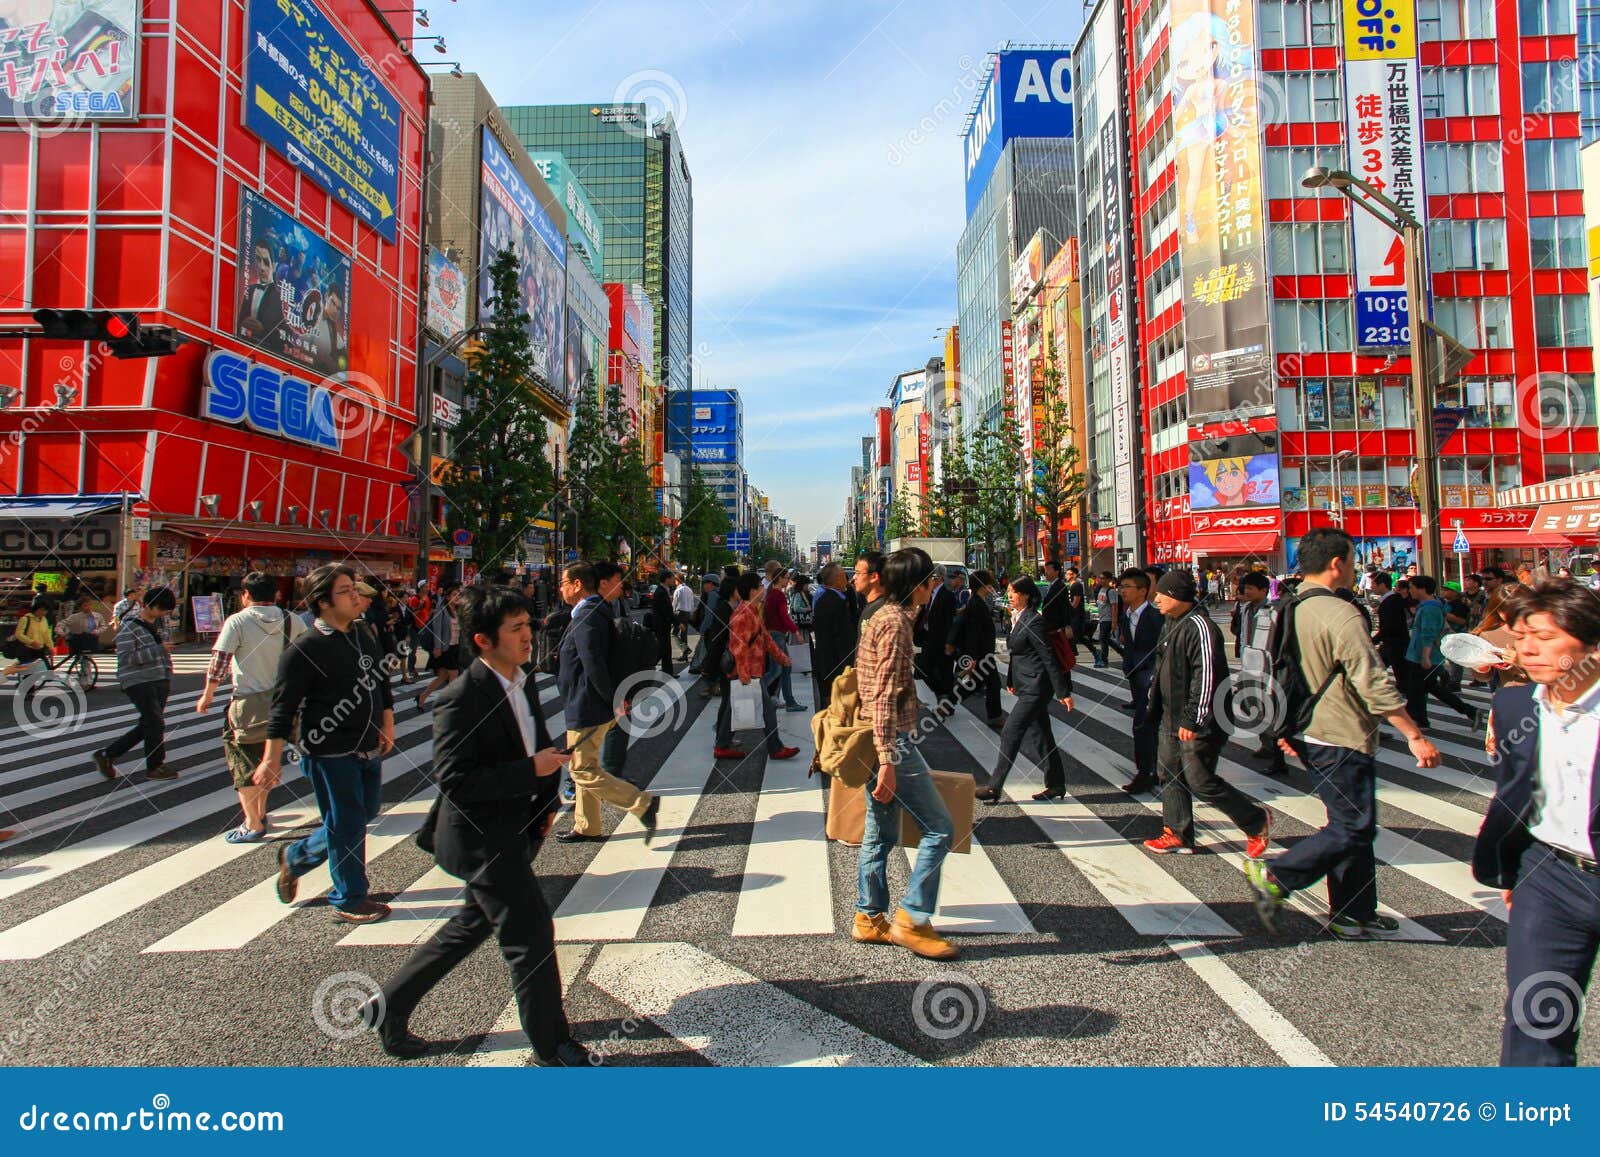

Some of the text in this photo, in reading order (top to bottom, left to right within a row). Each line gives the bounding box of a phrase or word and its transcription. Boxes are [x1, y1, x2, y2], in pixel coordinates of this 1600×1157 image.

[1357, 0, 1384, 52] OFF
[56, 91, 123, 112] SEGA
[967, 79, 996, 182] AOKI
[1365, 296, 1409, 313] 10:0
[1365, 326, 1411, 343] 23:0
[205, 349, 340, 451] SEGA
[691, 425, 727, 434] フマップ
[1213, 515, 1276, 527] ADORES
[1481, 512, 1529, 524] カラオケ
[1068, 532, 1076, 546] P
